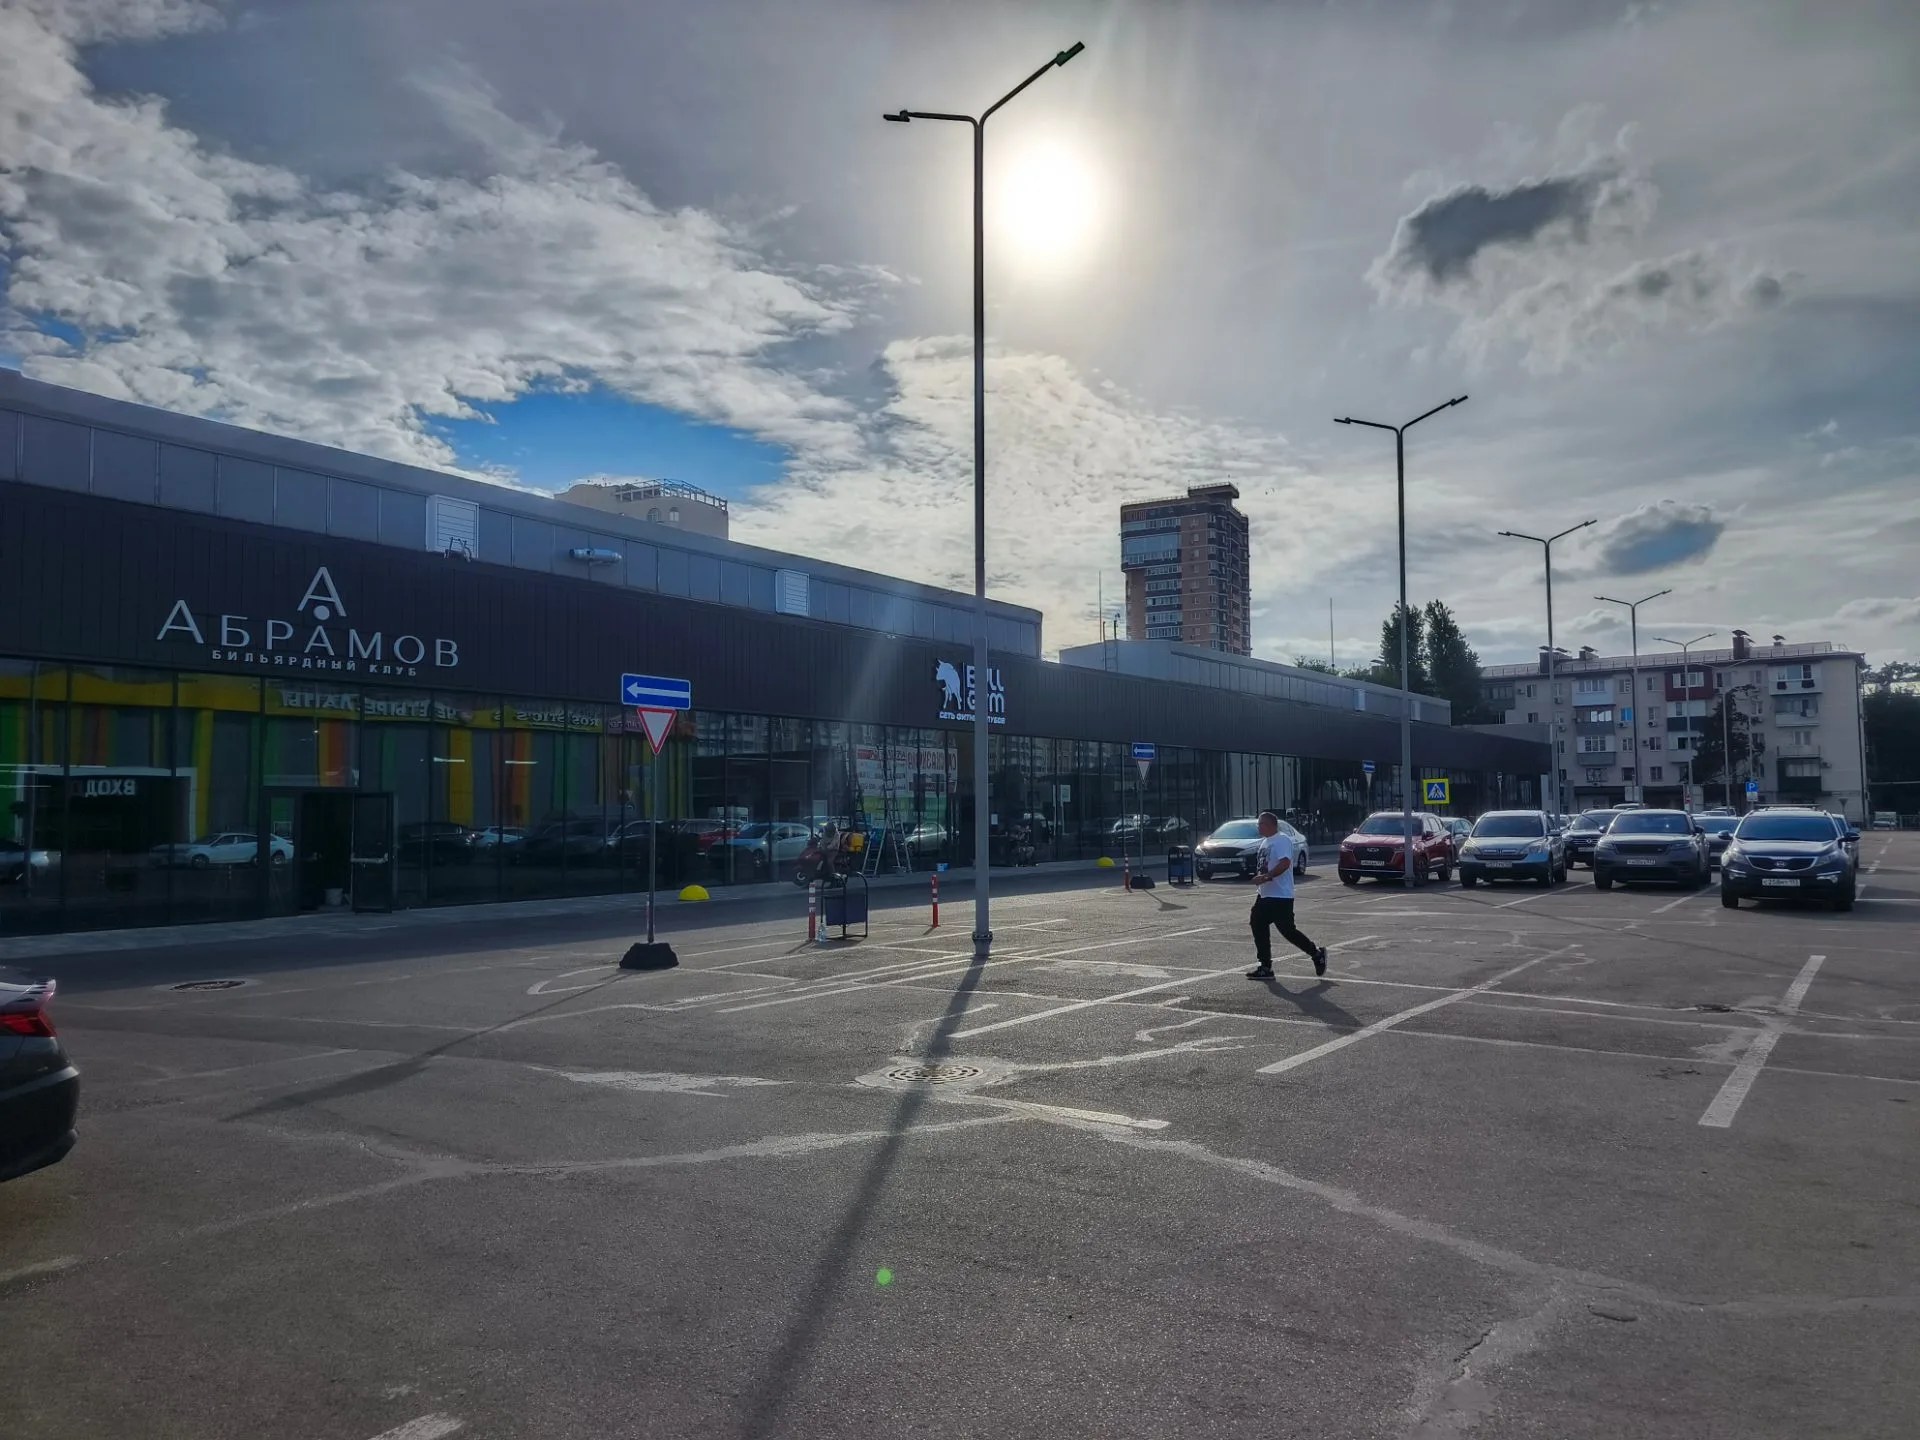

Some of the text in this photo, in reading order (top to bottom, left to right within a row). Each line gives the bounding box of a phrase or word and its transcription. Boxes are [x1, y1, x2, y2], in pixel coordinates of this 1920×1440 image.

[156, 599, 459, 667] АБРАМОВ
[212, 649, 416, 676] БИЛЬЯРДНЫЙ КЛУБ
[966, 665, 1005, 692] BLL
[966, 690, 1005, 713] GM
[1748, 782, 1755, 792] P
